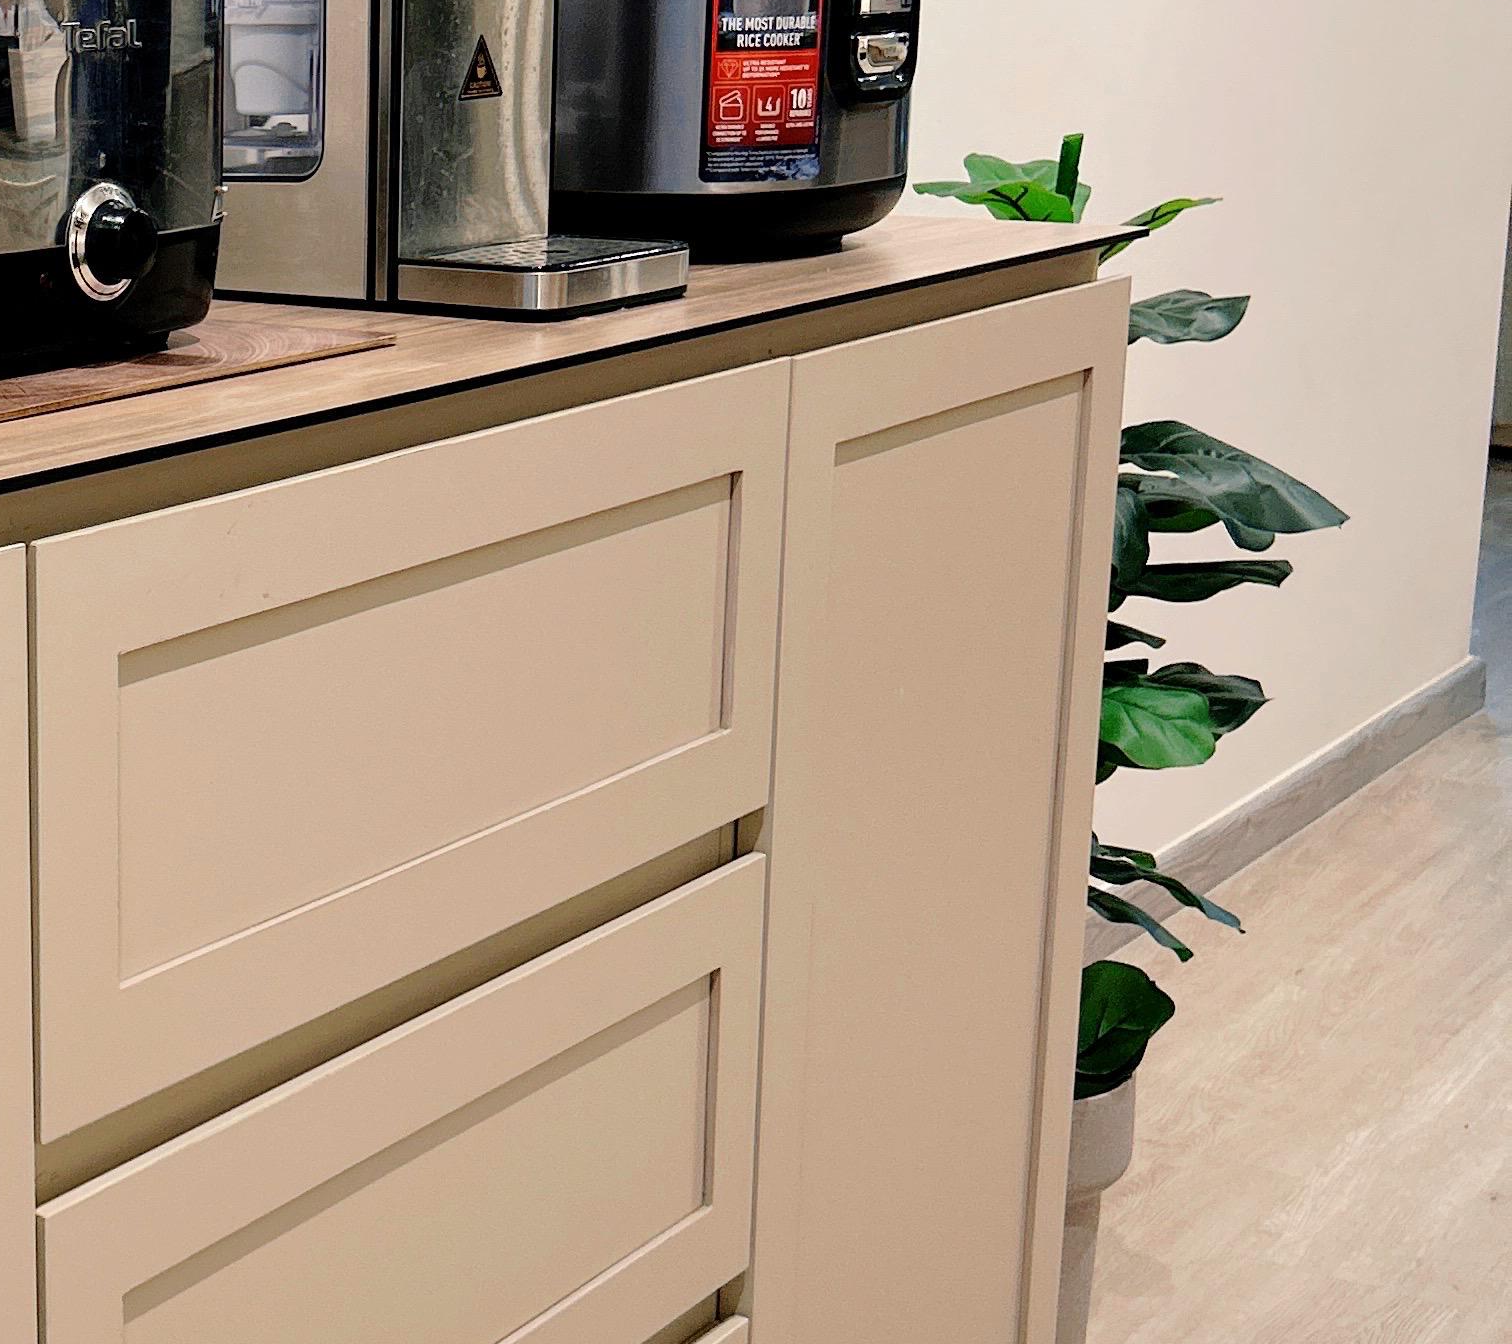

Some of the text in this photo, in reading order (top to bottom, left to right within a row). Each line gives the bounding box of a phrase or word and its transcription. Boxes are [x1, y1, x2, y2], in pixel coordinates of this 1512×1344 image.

[721, 14, 817, 32] THE MOST DURABLE
[60, 18, 143, 53] Tefal
[736, 33, 762, 48] RICE
[790, 87, 807, 109] 10
